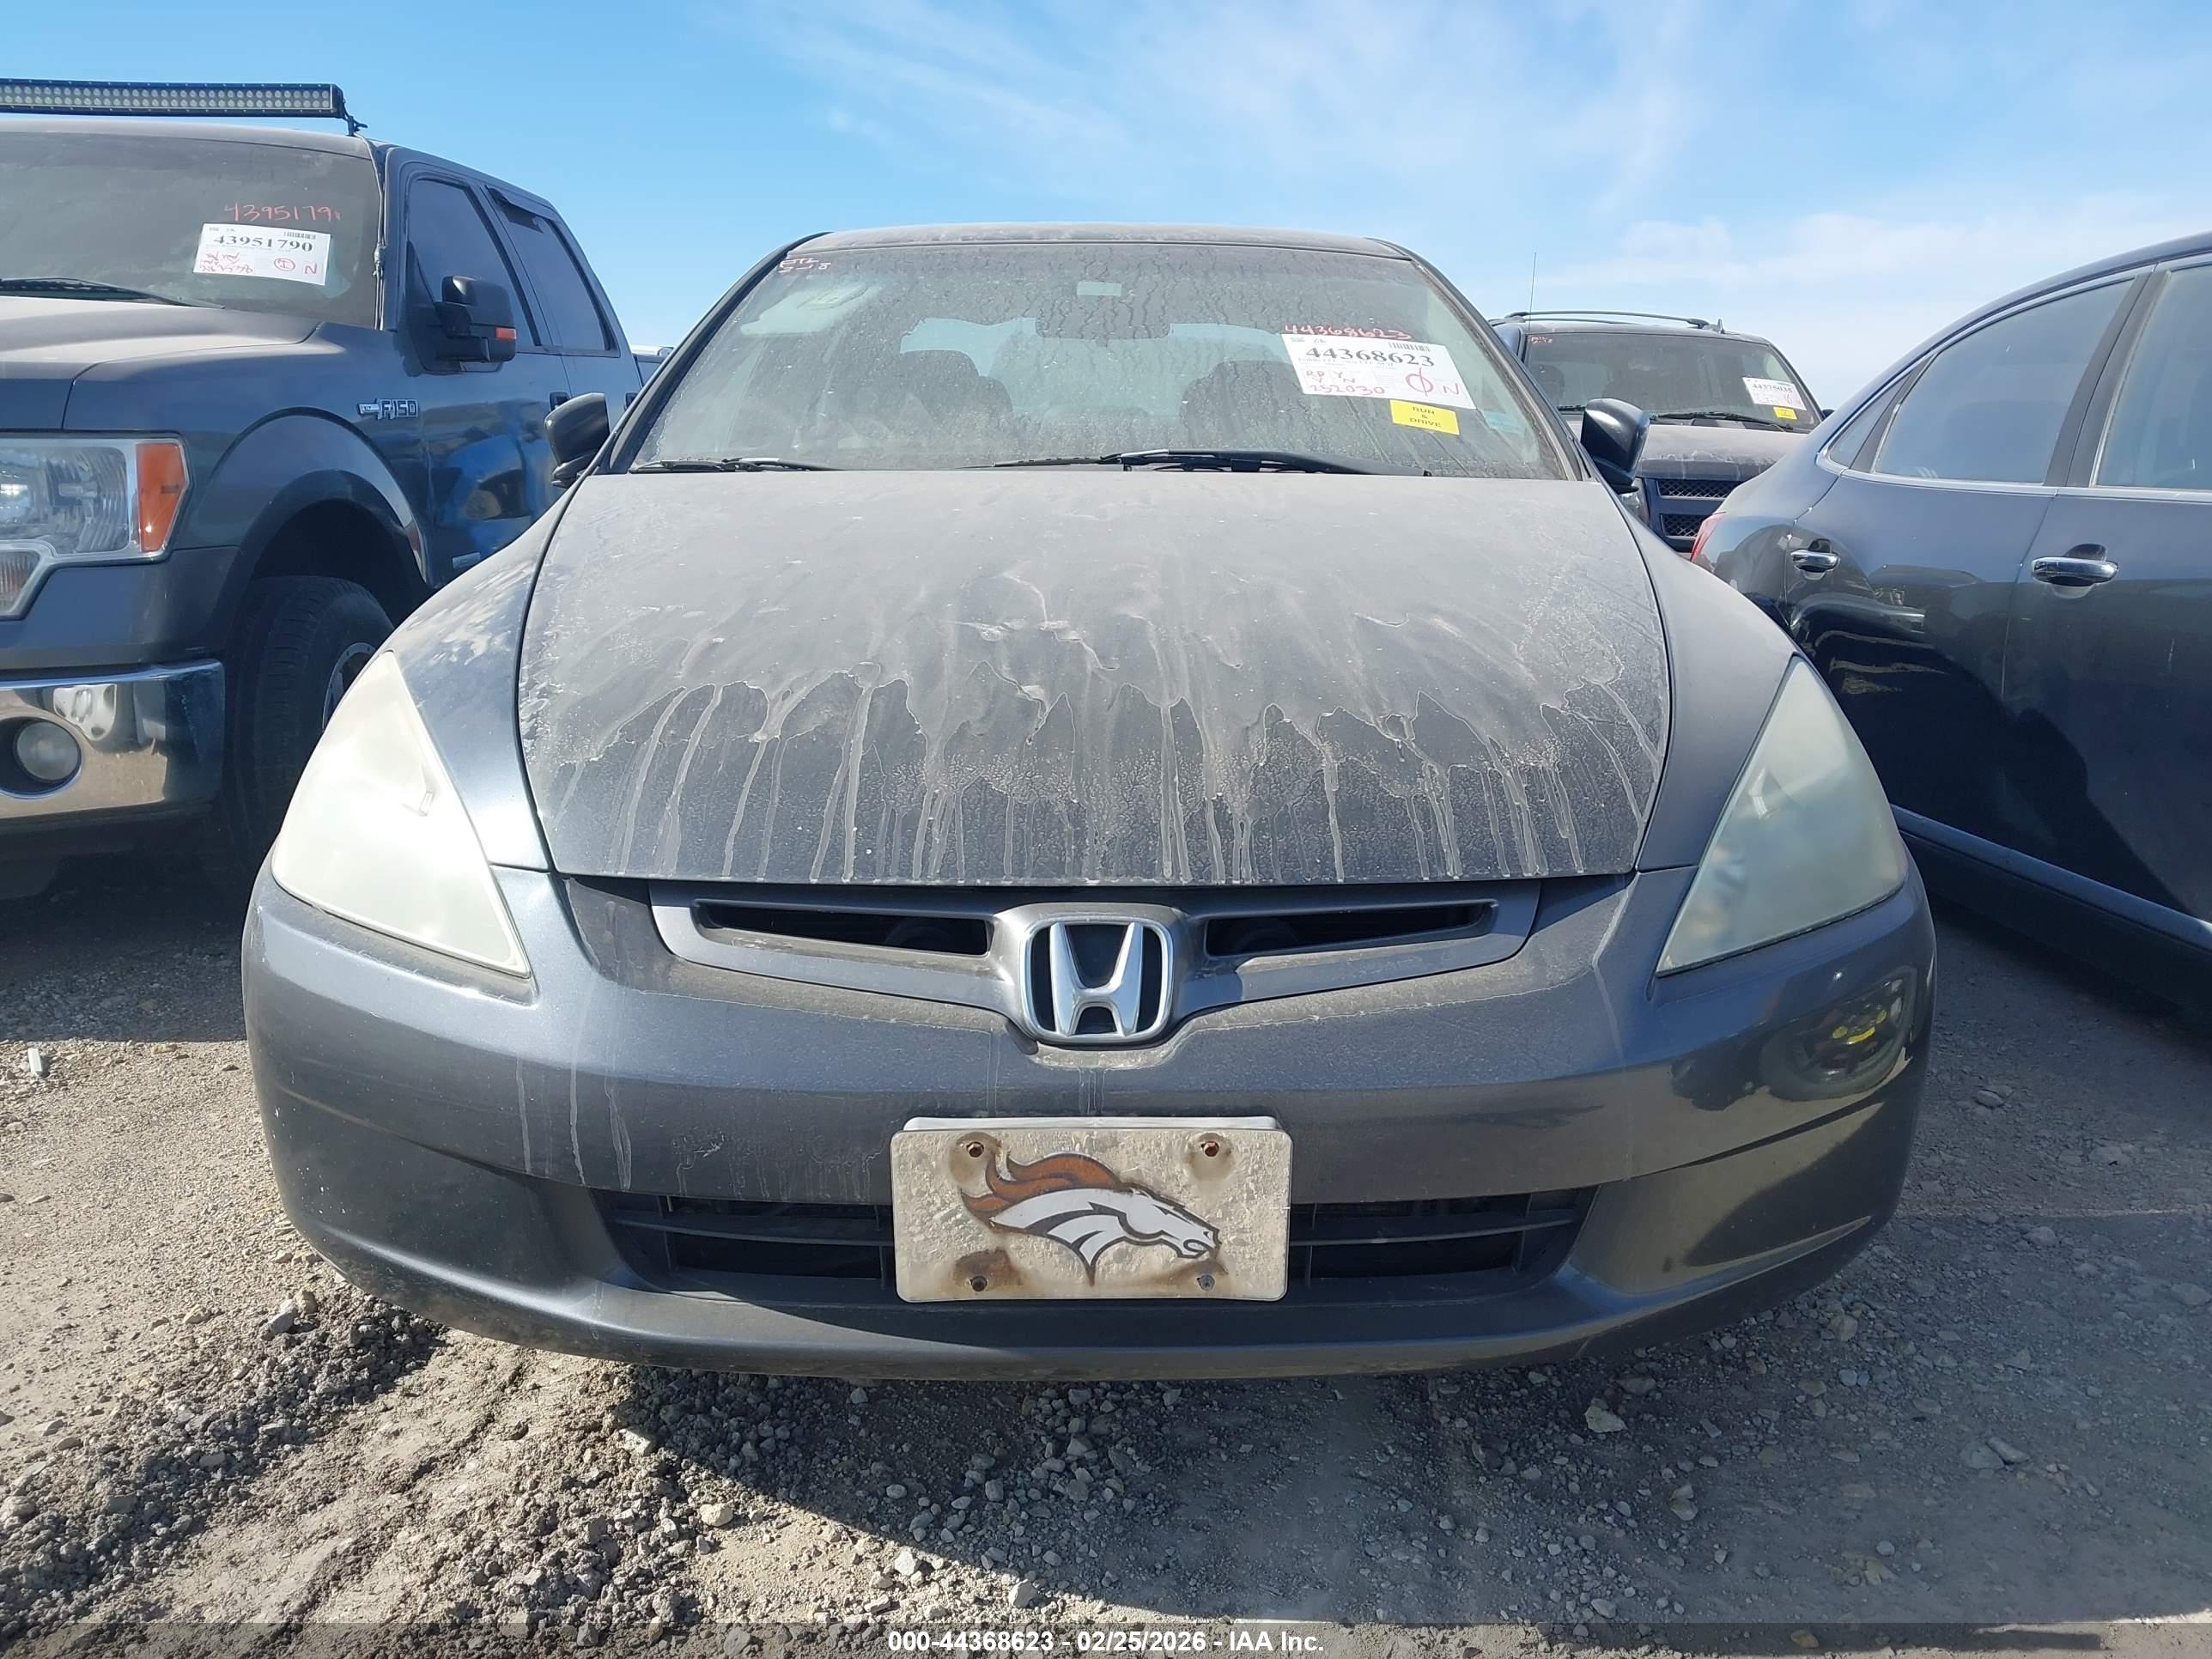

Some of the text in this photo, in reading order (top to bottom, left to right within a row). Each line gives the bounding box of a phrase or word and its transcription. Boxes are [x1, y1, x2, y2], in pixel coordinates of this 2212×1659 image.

[213, 234, 313, 252] 43951790
[1285, 325, 1413, 339] 44368623
[1306, 347, 1435, 367] 44368623
[1443, 383, 1460, 395] N
[1412, 406, 1435, 415] RUN
[1409, 417, 1442, 427] DRIVE
